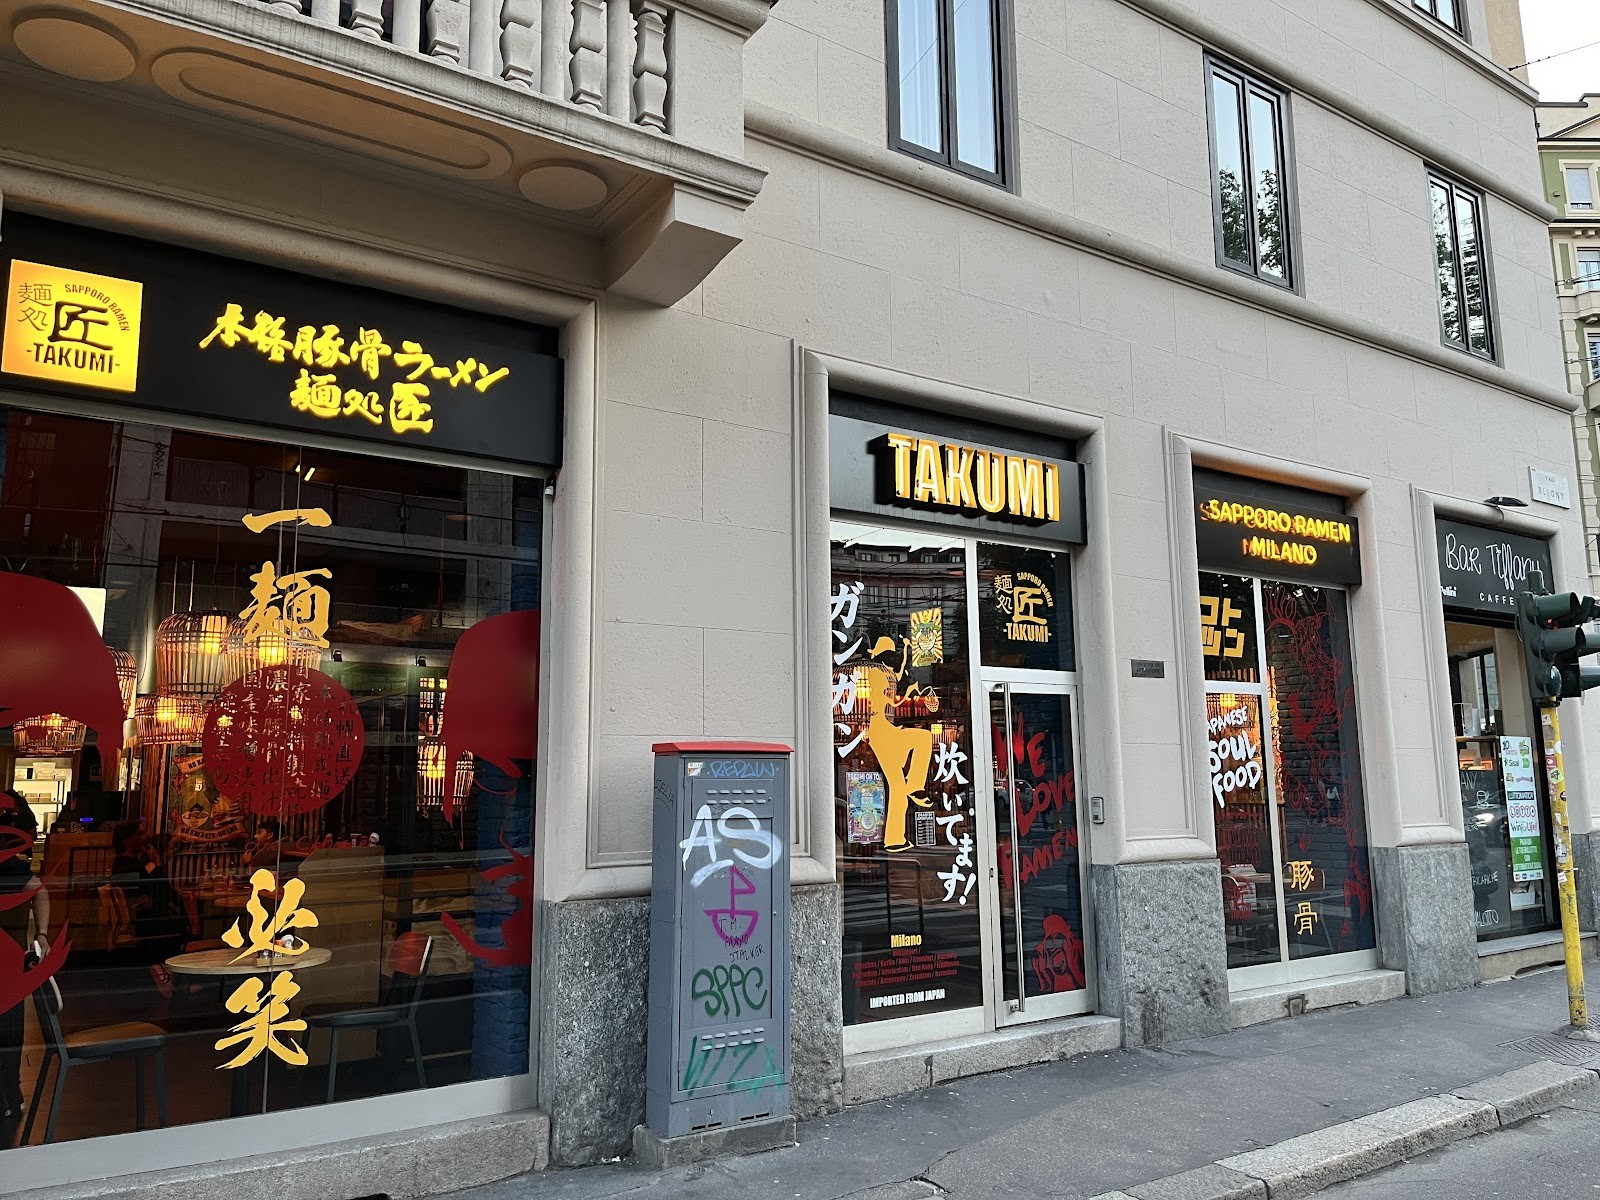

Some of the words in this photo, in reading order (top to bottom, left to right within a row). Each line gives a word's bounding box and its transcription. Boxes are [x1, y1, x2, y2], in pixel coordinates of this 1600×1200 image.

[17, 282, 53, 331] 麺処
[47, 300, 113, 351] 匠
[64, 284, 111, 303] SAPPORO
[108, 302, 130, 331] RAMEN
[199, 303, 509, 392] 本格豚骨ラーメン
[290, 369, 434, 434] 麺処匠
[887, 432, 1060, 522] TAKUMI
[1538, 486, 1564, 500] BLIGNY
[1208, 499, 1291, 533] SAPPORO
[1294, 514, 1351, 543] RAMEN
[1252, 536, 1317, 565] MILANO
[994, 574, 1014, 614] 麺処
[1012, 586, 1048, 625] 匠
[1016, 572, 1042, 586] SAPPORO
[1040, 583, 1054, 607] RAMEN
[831, 581, 867, 758] ガンガン
[1207, 705, 1248, 735] APANESE
[992, 711, 1046, 778] WE
[1208, 730, 1257, 774] SOUL
[1015, 769, 1075, 837] LOVE
[1213, 761, 1261, 809] FOOD
[1510, 805, 1536, 818] LOTTO
[679, 804, 783, 872] AS
[998, 826, 1078, 891] RAMEN
[1291, 860, 1318, 936] 豚骨
[891, 934, 922, 948] Milano
[869, 993, 905, 1009] IMPORTED
[905, 991, 925, 1004] FROM
[925, 988, 946, 1001] JAPAN
